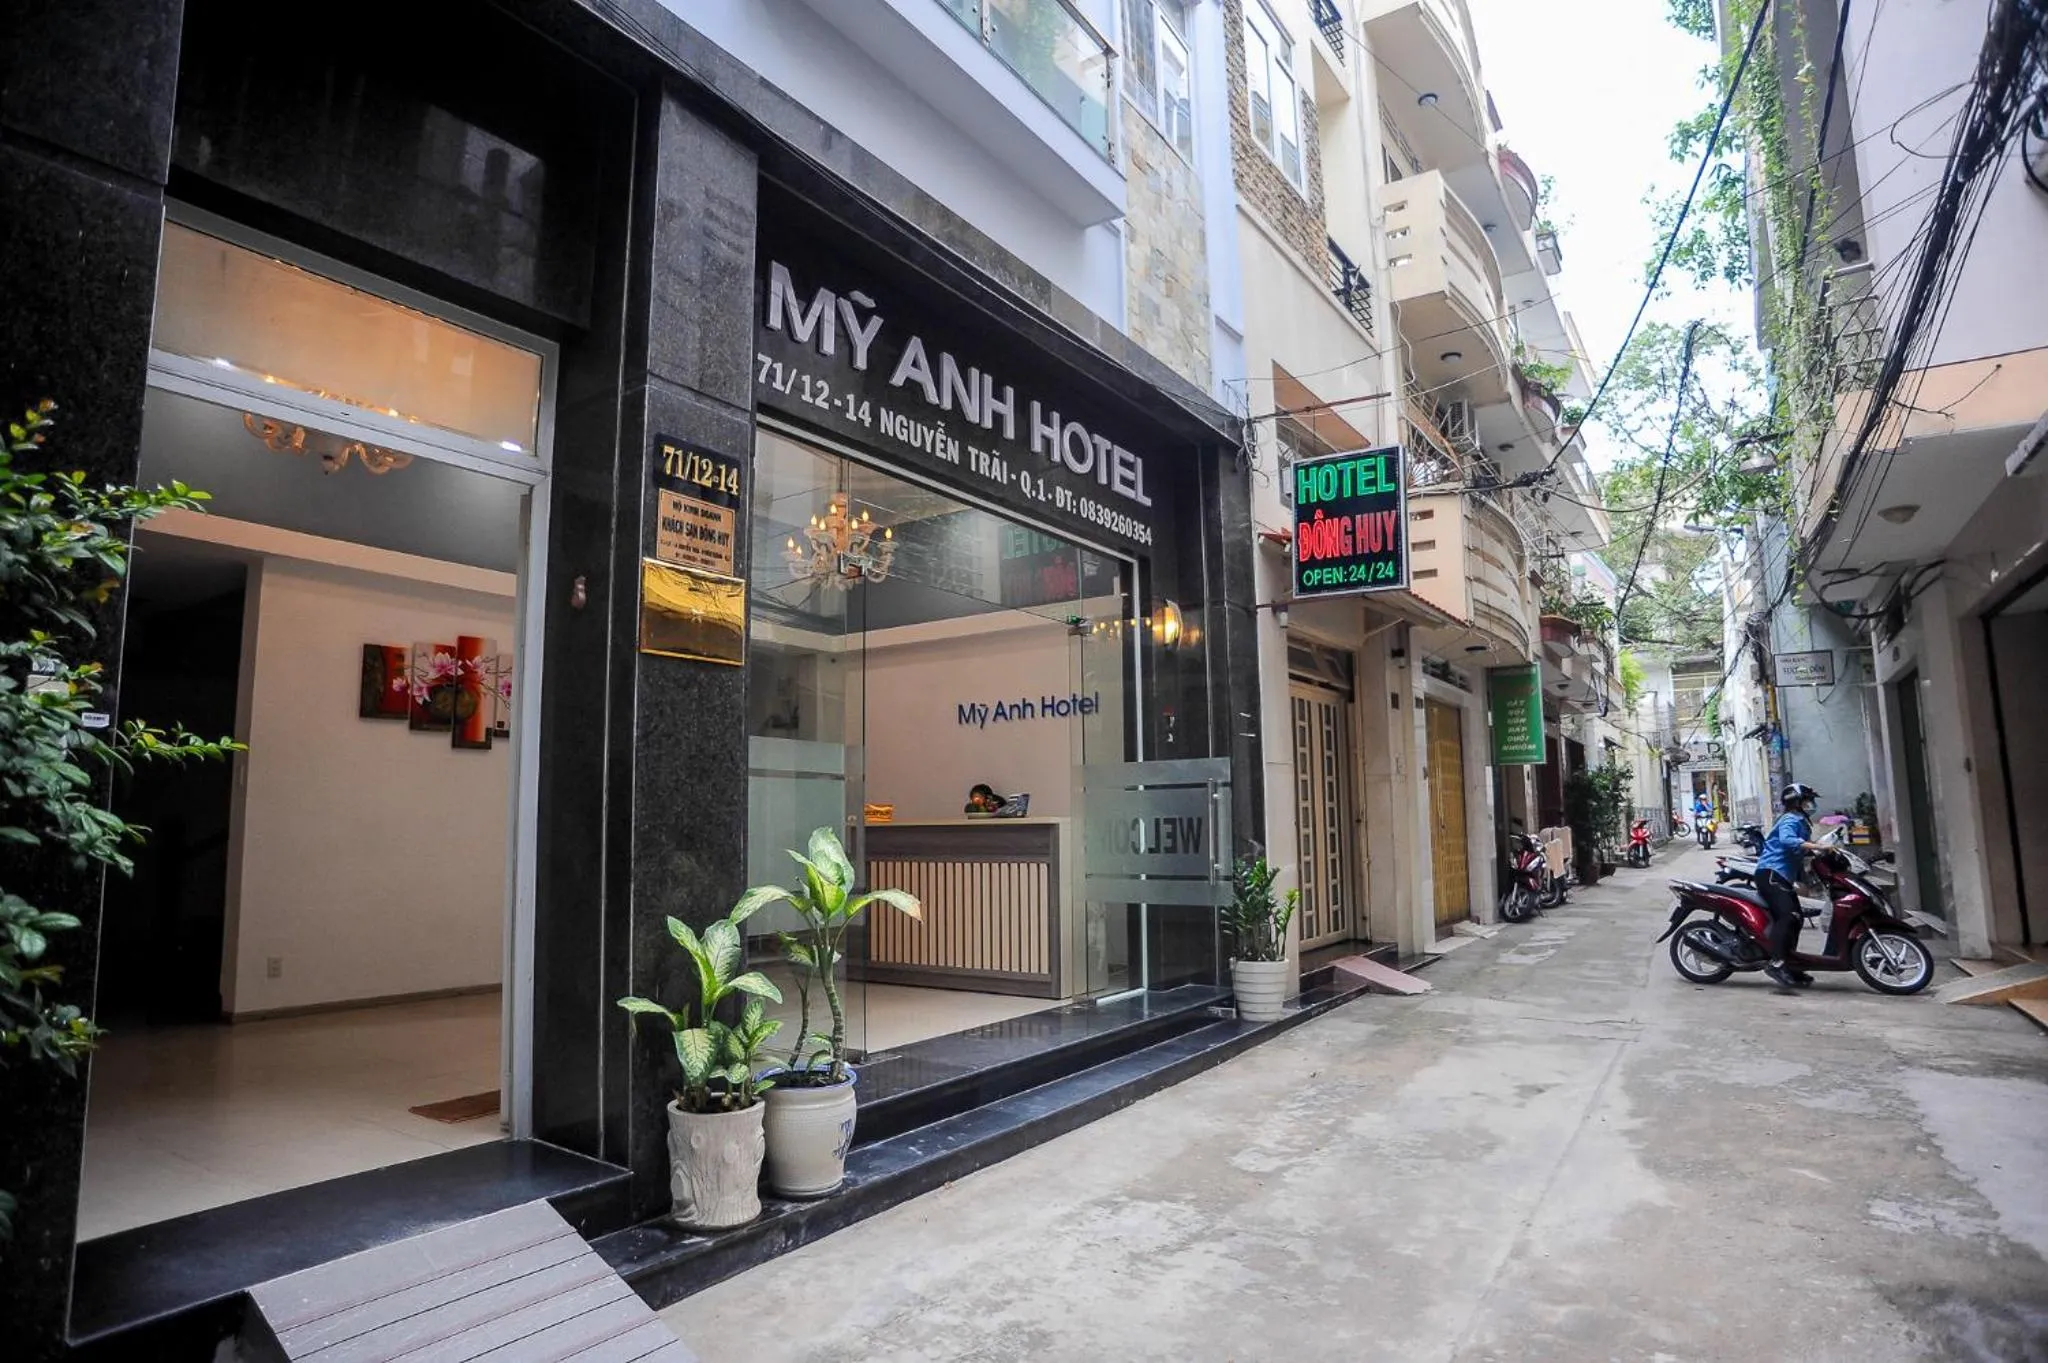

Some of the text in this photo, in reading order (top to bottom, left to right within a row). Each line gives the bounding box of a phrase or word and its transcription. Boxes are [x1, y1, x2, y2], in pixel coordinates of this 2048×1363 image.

[766, 260, 1152, 507] MỸ ANH HOTEL
[880, 407, 960, 466] NGUYỄN
[967, 444, 1008, 485] TRÃI
[1079, 497, 1152, 546] 0839260354
[1297, 454, 1396, 505] HOTEL
[1355, 510, 1397, 555] HUY
[958, 690, 1099, 730] Mỹ Anh Hotel
